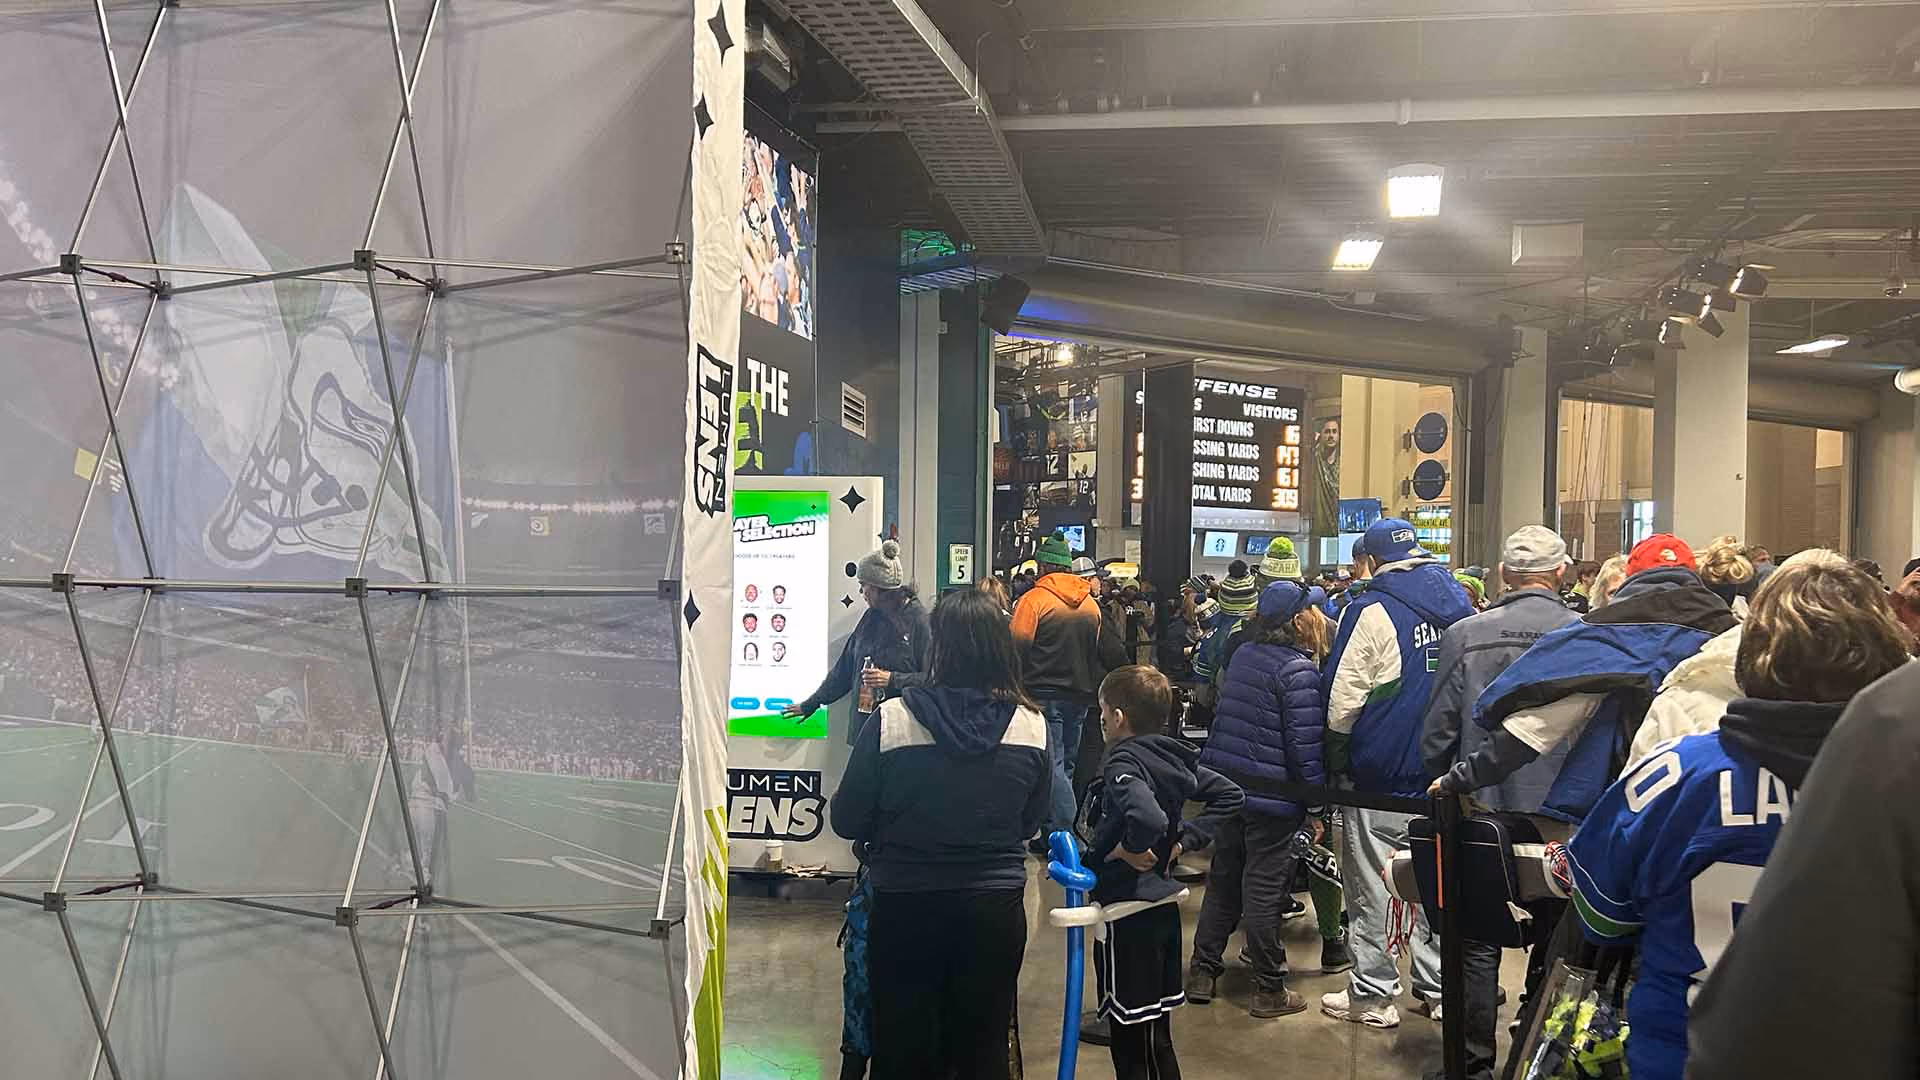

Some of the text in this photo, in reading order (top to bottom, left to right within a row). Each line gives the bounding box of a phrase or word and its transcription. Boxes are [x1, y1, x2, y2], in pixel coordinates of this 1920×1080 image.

[746, 357, 789, 417] THE
[1243, 402, 1298, 421] VISITORS
[697, 352, 722, 510] LENS
[714, 369, 732, 502] LUMEN
[1194, 416, 1216, 434] IRST
[1216, 420, 1254, 437] DOWNS
[1193, 439, 1226, 457] SSING
[1227, 443, 1260, 460] YARDS
[1045, 454, 1059, 475] 12
[1193, 462, 1226, 478] SHING
[1227, 465, 1260, 482] YARDS
[1193, 484, 1217, 501] OTAL
[1218, 486, 1252, 503] YARDS
[734, 515, 769, 532] AYER
[741, 521, 815, 542] SELECTION
[957, 565, 965, 580] 5
[1268, 561, 1298, 574] SEAHA
[727, 773, 814, 793] UMEN
[1719, 767, 1800, 827] LA
[728, 795, 820, 836] ENS
